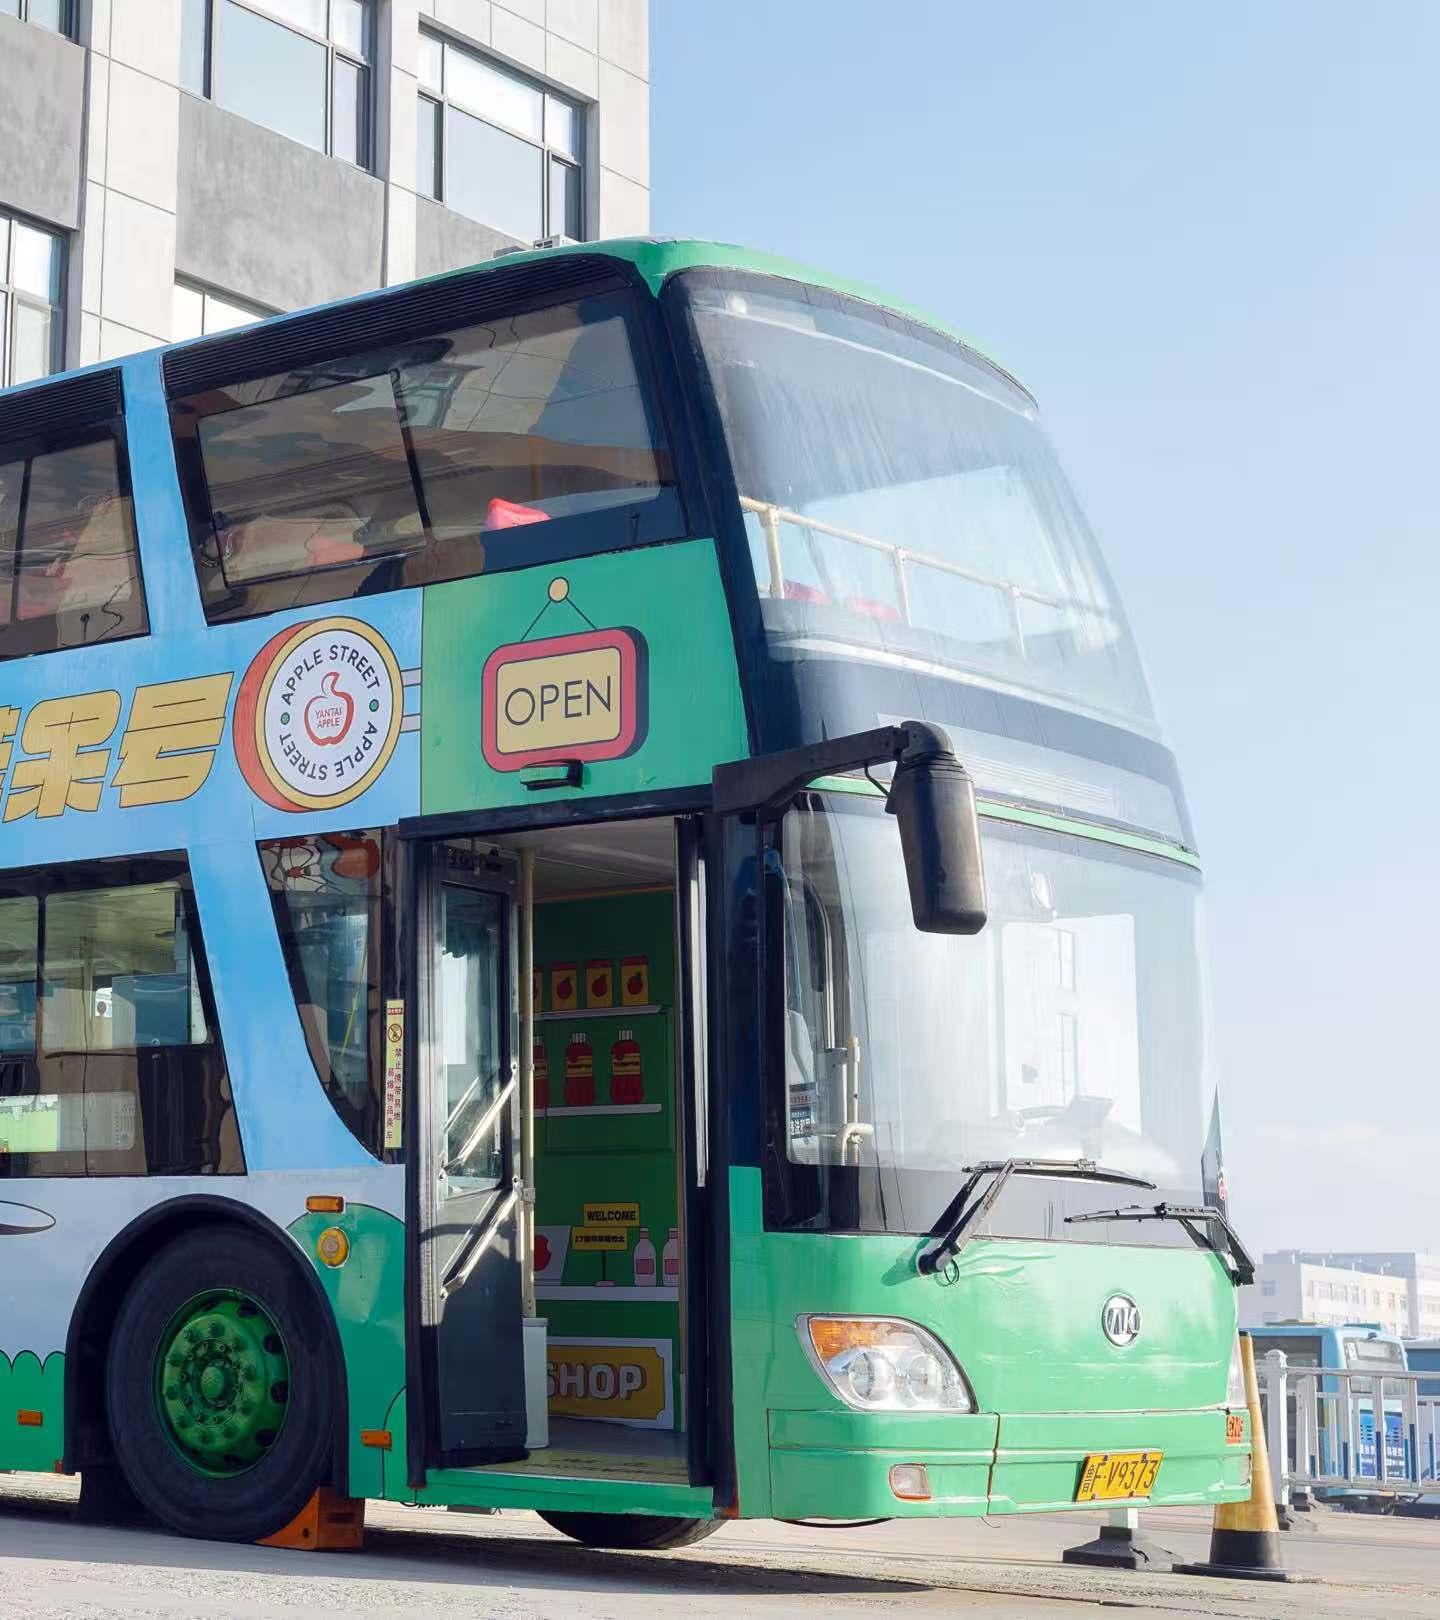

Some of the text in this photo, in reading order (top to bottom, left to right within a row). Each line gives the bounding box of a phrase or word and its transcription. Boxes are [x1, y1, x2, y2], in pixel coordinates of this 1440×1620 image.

[281, 644, 380, 706] APPLE STREET
[314, 707, 342, 719] YANTAI
[504, 675, 611, 726] OPEN
[316, 717, 341, 729] APPLE
[279, 721, 378, 781] APPLE STREET
[587, 1210, 636, 1221] WELCOME
